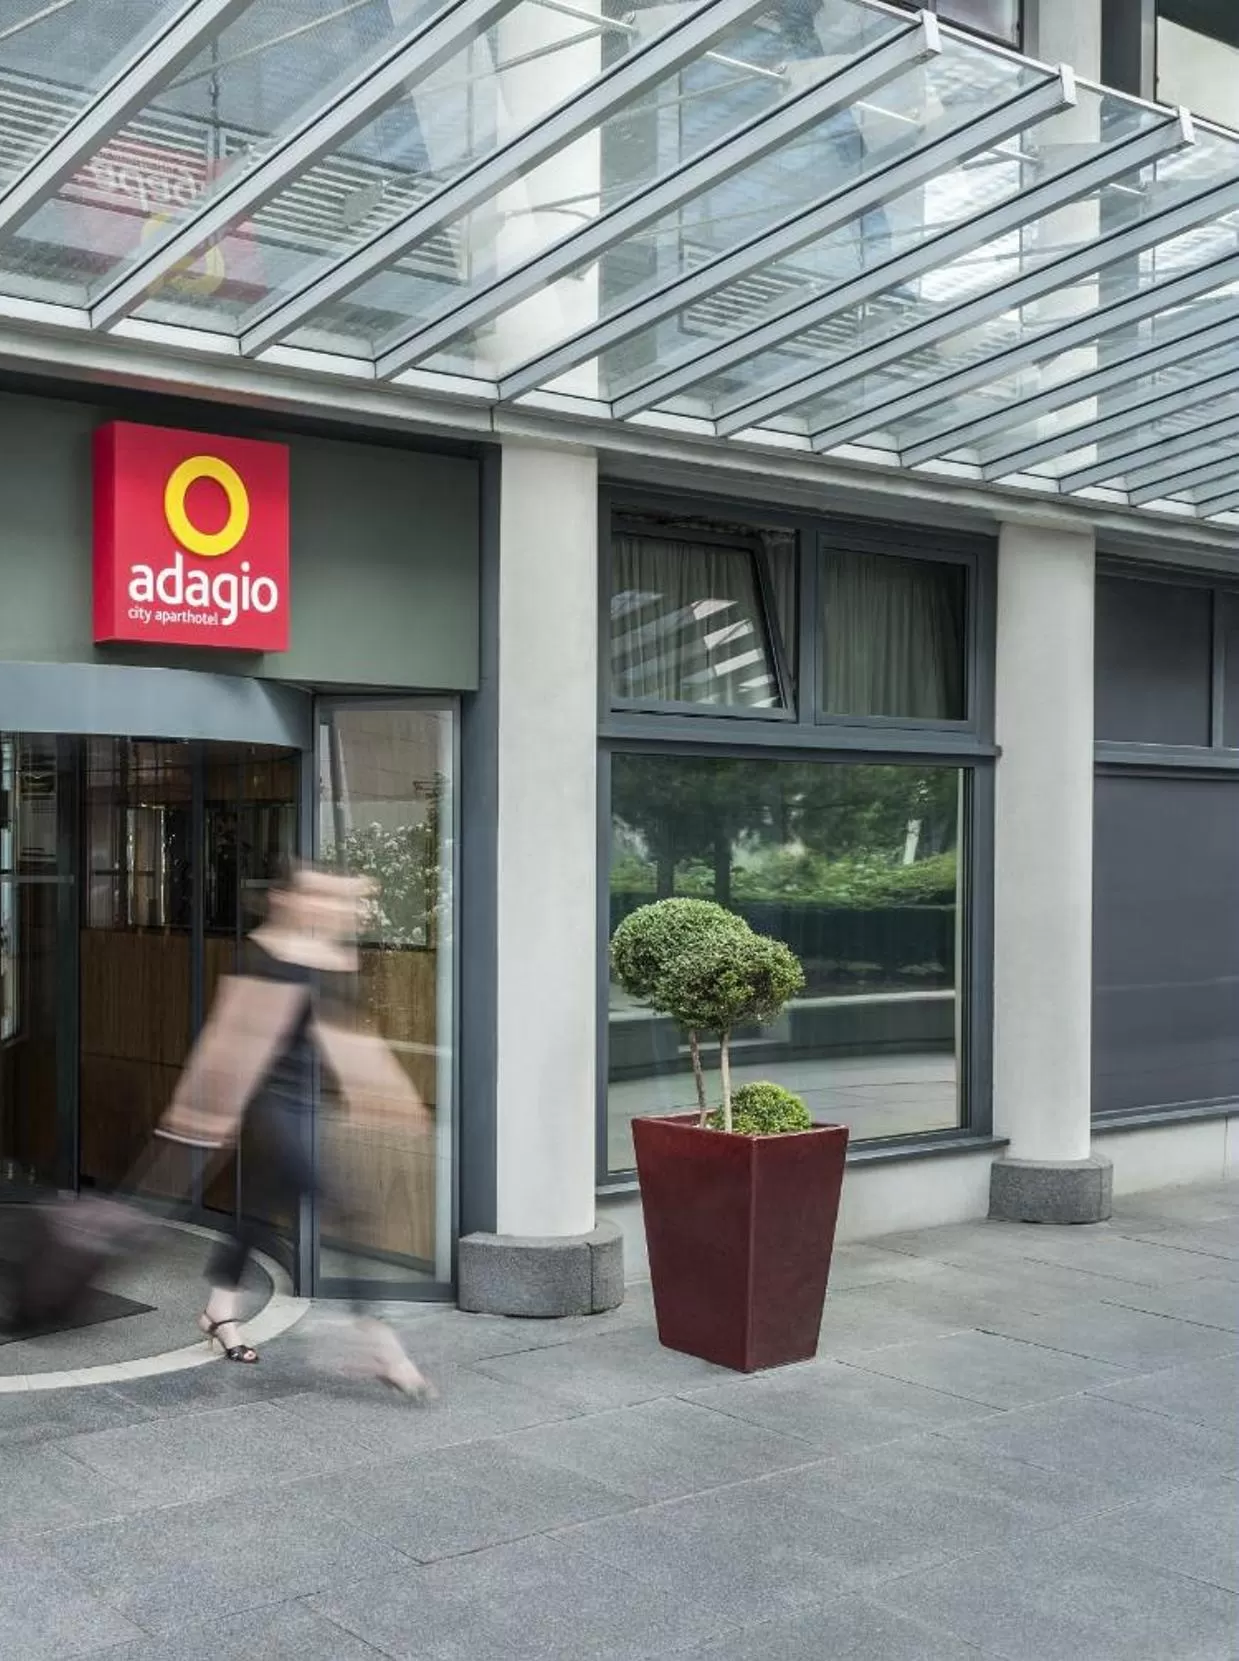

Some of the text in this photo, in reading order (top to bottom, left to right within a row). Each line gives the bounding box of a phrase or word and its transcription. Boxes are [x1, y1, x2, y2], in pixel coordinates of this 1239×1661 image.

[128, 551, 279, 625] adagio
[128, 606, 219, 625] city aparthotel
